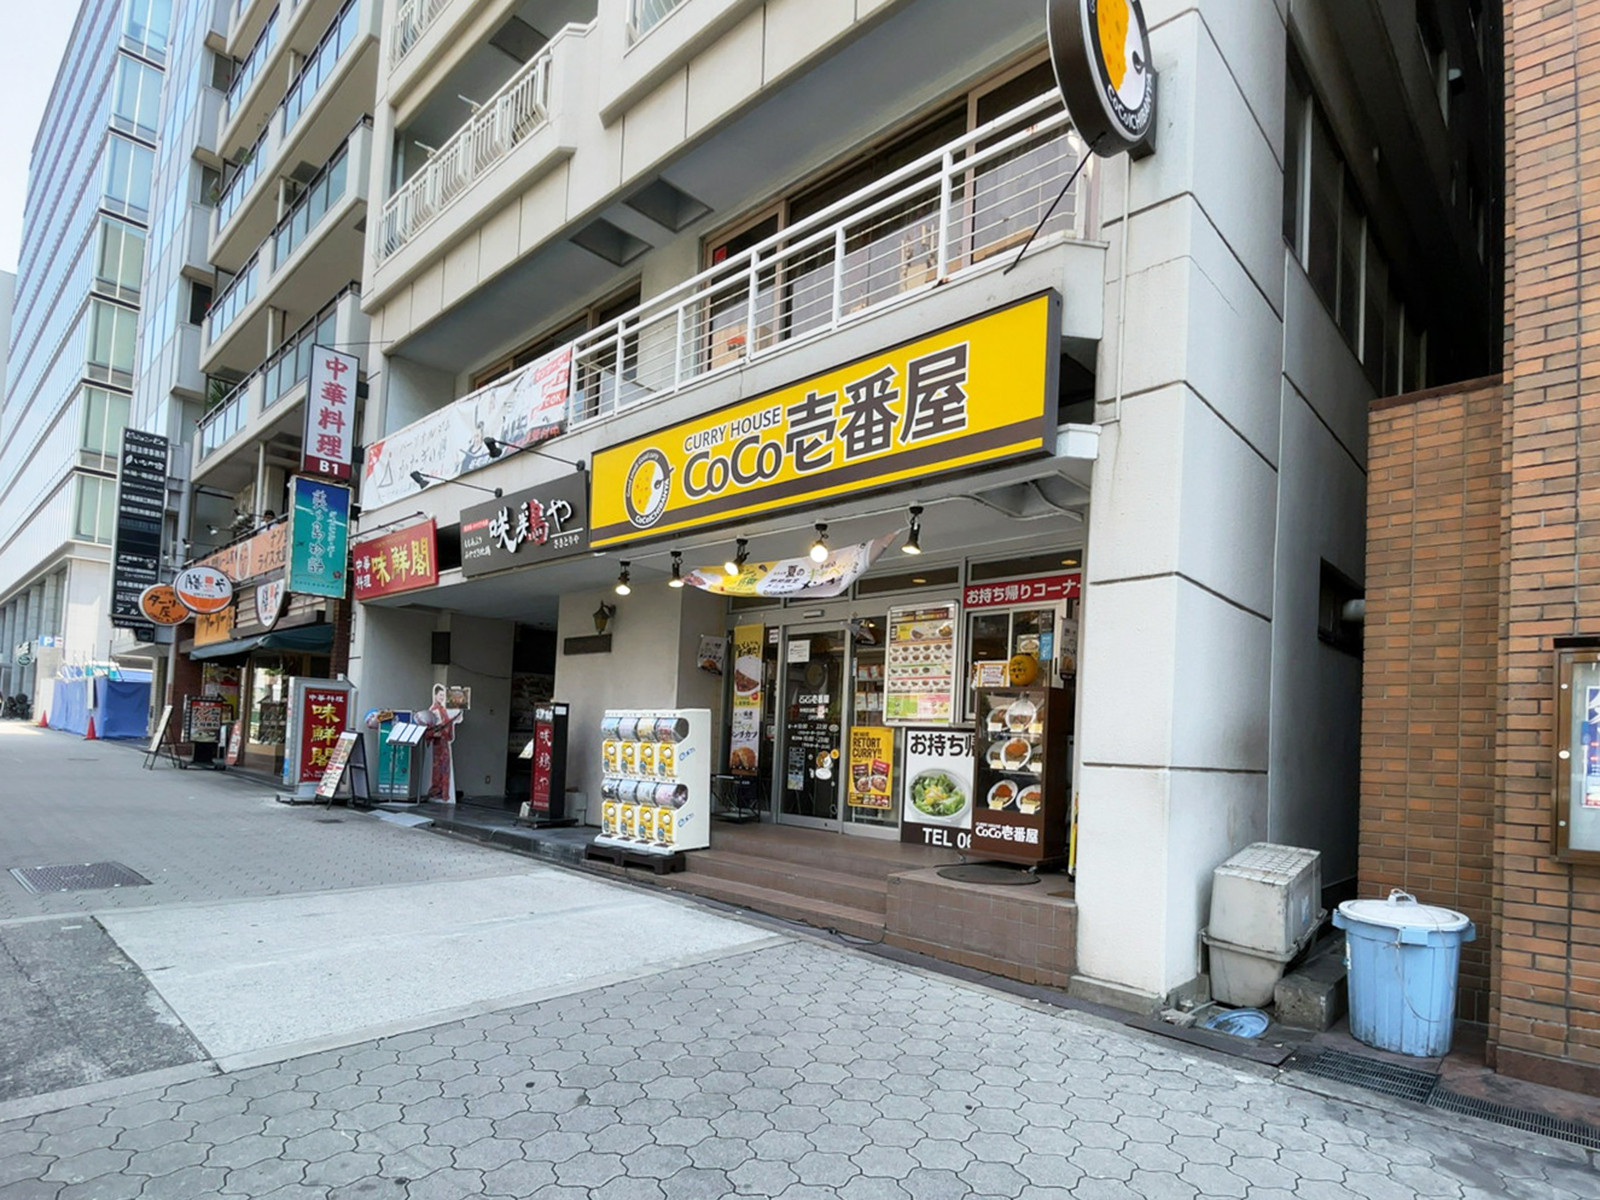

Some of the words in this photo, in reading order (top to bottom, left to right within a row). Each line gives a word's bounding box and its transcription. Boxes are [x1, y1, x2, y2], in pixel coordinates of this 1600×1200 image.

[316, 356, 348, 459] 中華料理
[682, 341, 970, 499] CoCo壱番屋
[684, 425, 726, 452] CURRY
[730, 406, 782, 440] HOUSE
[319, 459, 339, 475] B1
[371, 536, 430, 588] 味鮮閣
[966, 579, 1081, 604] お持ち帰りコーナ
[852, 737, 881, 749] RETORT
[922, 827, 953, 847] TEL
[975, 825, 1038, 844] CoCo壱番屋
